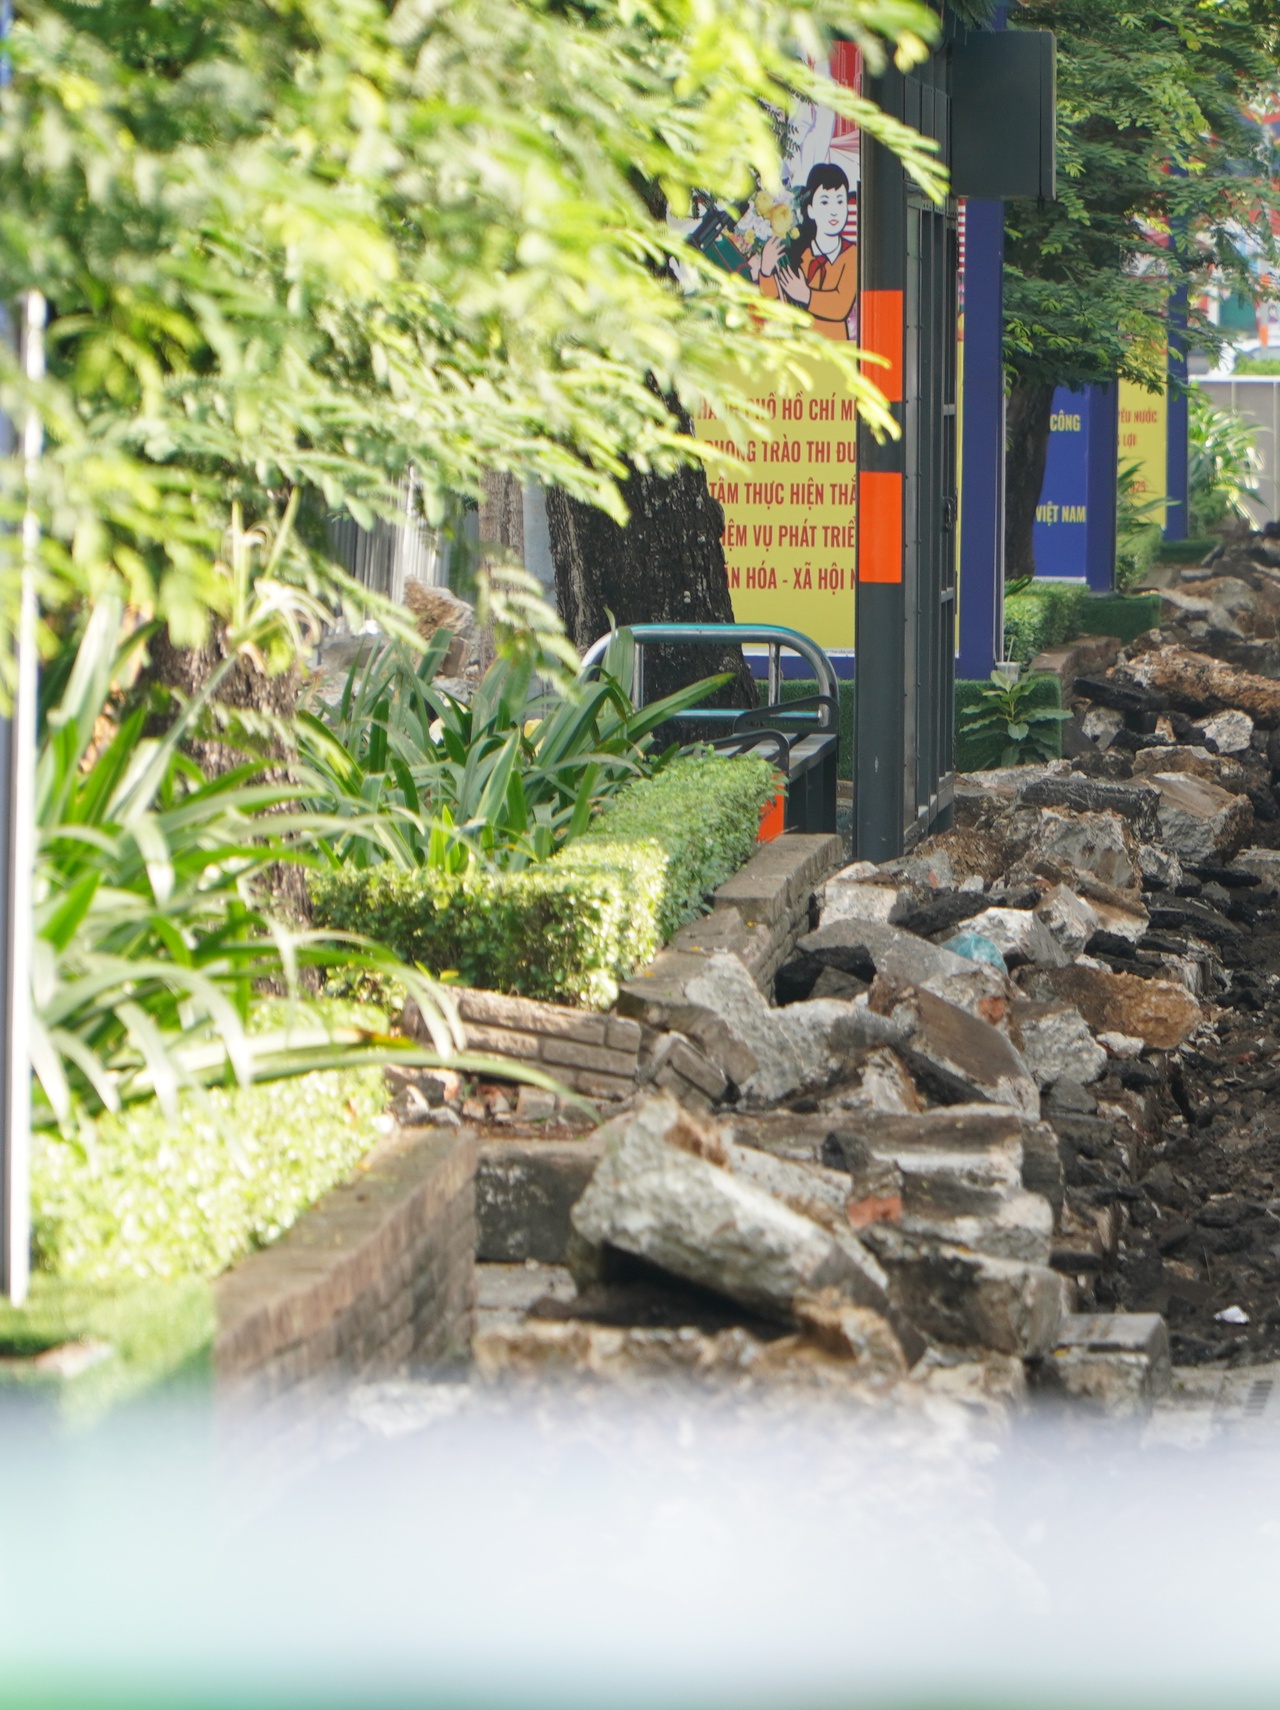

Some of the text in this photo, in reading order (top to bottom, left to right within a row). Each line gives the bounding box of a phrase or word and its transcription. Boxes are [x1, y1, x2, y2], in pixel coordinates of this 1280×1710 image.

[781, 391, 804, 421] HỒ
[808, 392, 836, 421] CHÍ
[1049, 409, 1081, 432] CÔNG
[761, 434, 802, 463] TRÀO
[806, 441, 831, 463] THI
[709, 476, 739, 504] TÂM
[744, 481, 785, 510] THỰC
[790, 477, 825, 511] HIỆN
[1035, 501, 1087, 527] VIỆT NAM
[753, 525, 774, 552] VỤ
[778, 519, 818, 548] PHÁT
[746, 560, 778, 590] HÓA
[793, 562, 813, 590] XÃ
[818, 562, 845, 595] HỘI
